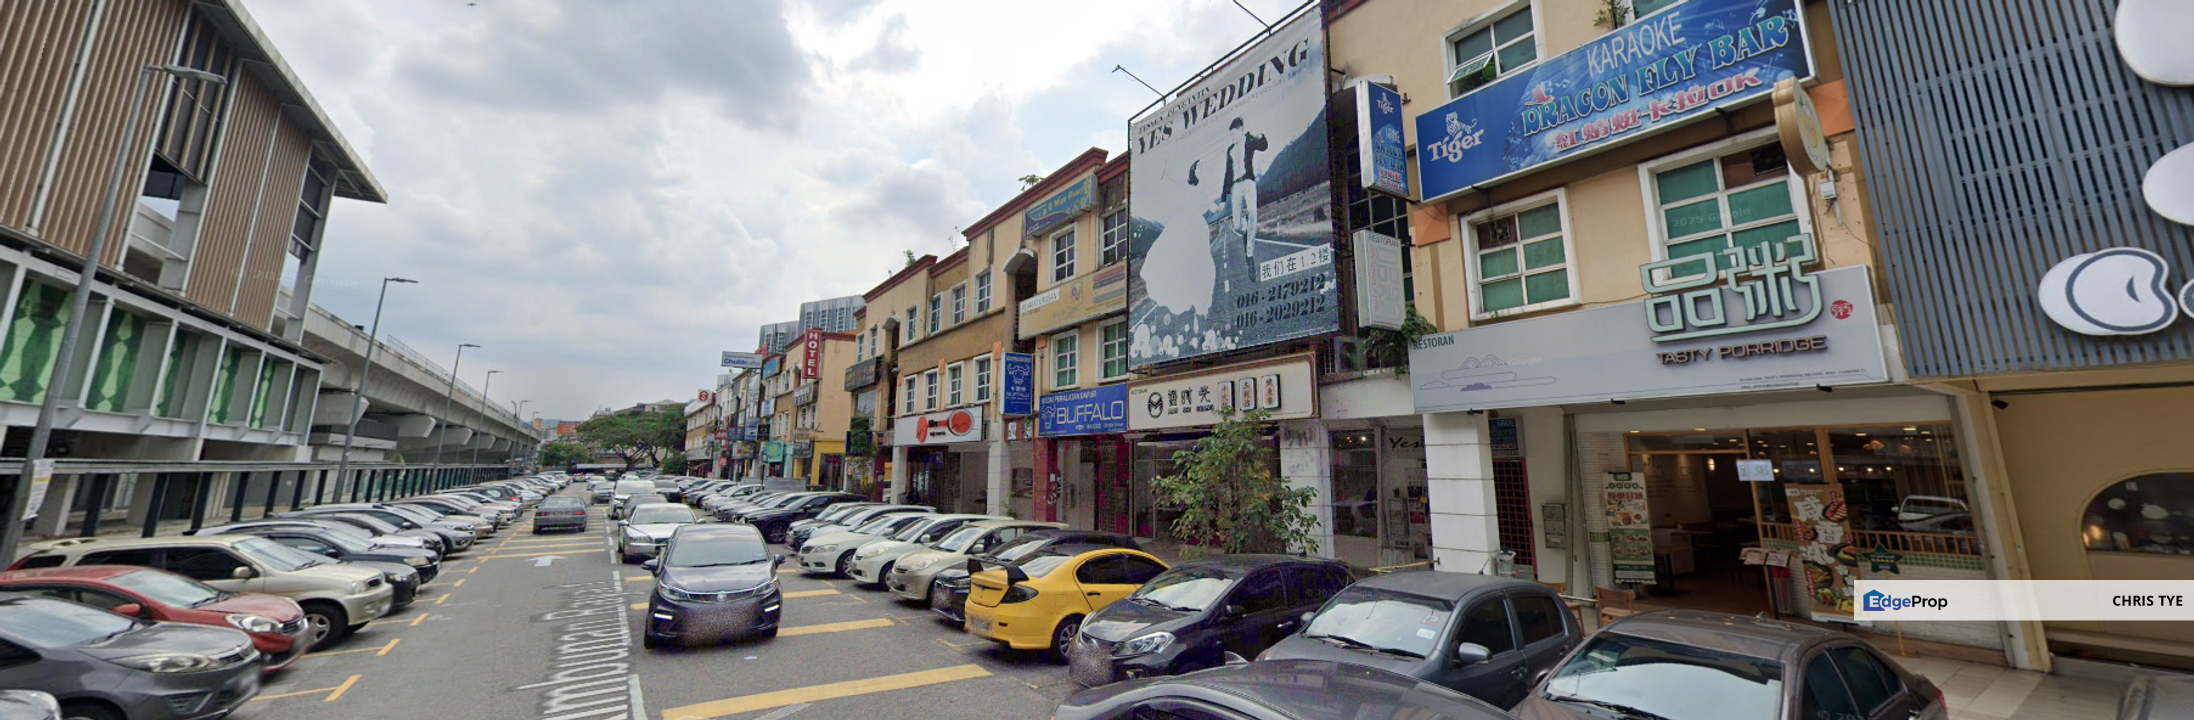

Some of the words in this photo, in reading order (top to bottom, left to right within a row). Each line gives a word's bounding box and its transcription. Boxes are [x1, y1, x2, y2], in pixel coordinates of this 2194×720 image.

[1586, 10, 1686, 77] KARAOKE
[1522, 75, 1630, 137] DRAGON
[1637, 44, 1700, 97] FLY
[1708, 15, 1790, 71] BAR
[1138, 120, 1174, 155] YES
[1182, 37, 1310, 130] WEDDING
[1427, 129, 1485, 163] Tiger
[1368, 234, 1399, 248] RESTORAN
[807, 332, 819, 376] HOTEL
[1414, 335, 1455, 351] RESTORAN
[1656, 348, 1712, 365] TASTY
[1718, 335, 1828, 359] PORRIDGE
[1056, 400, 1124, 425] BUFFALO
